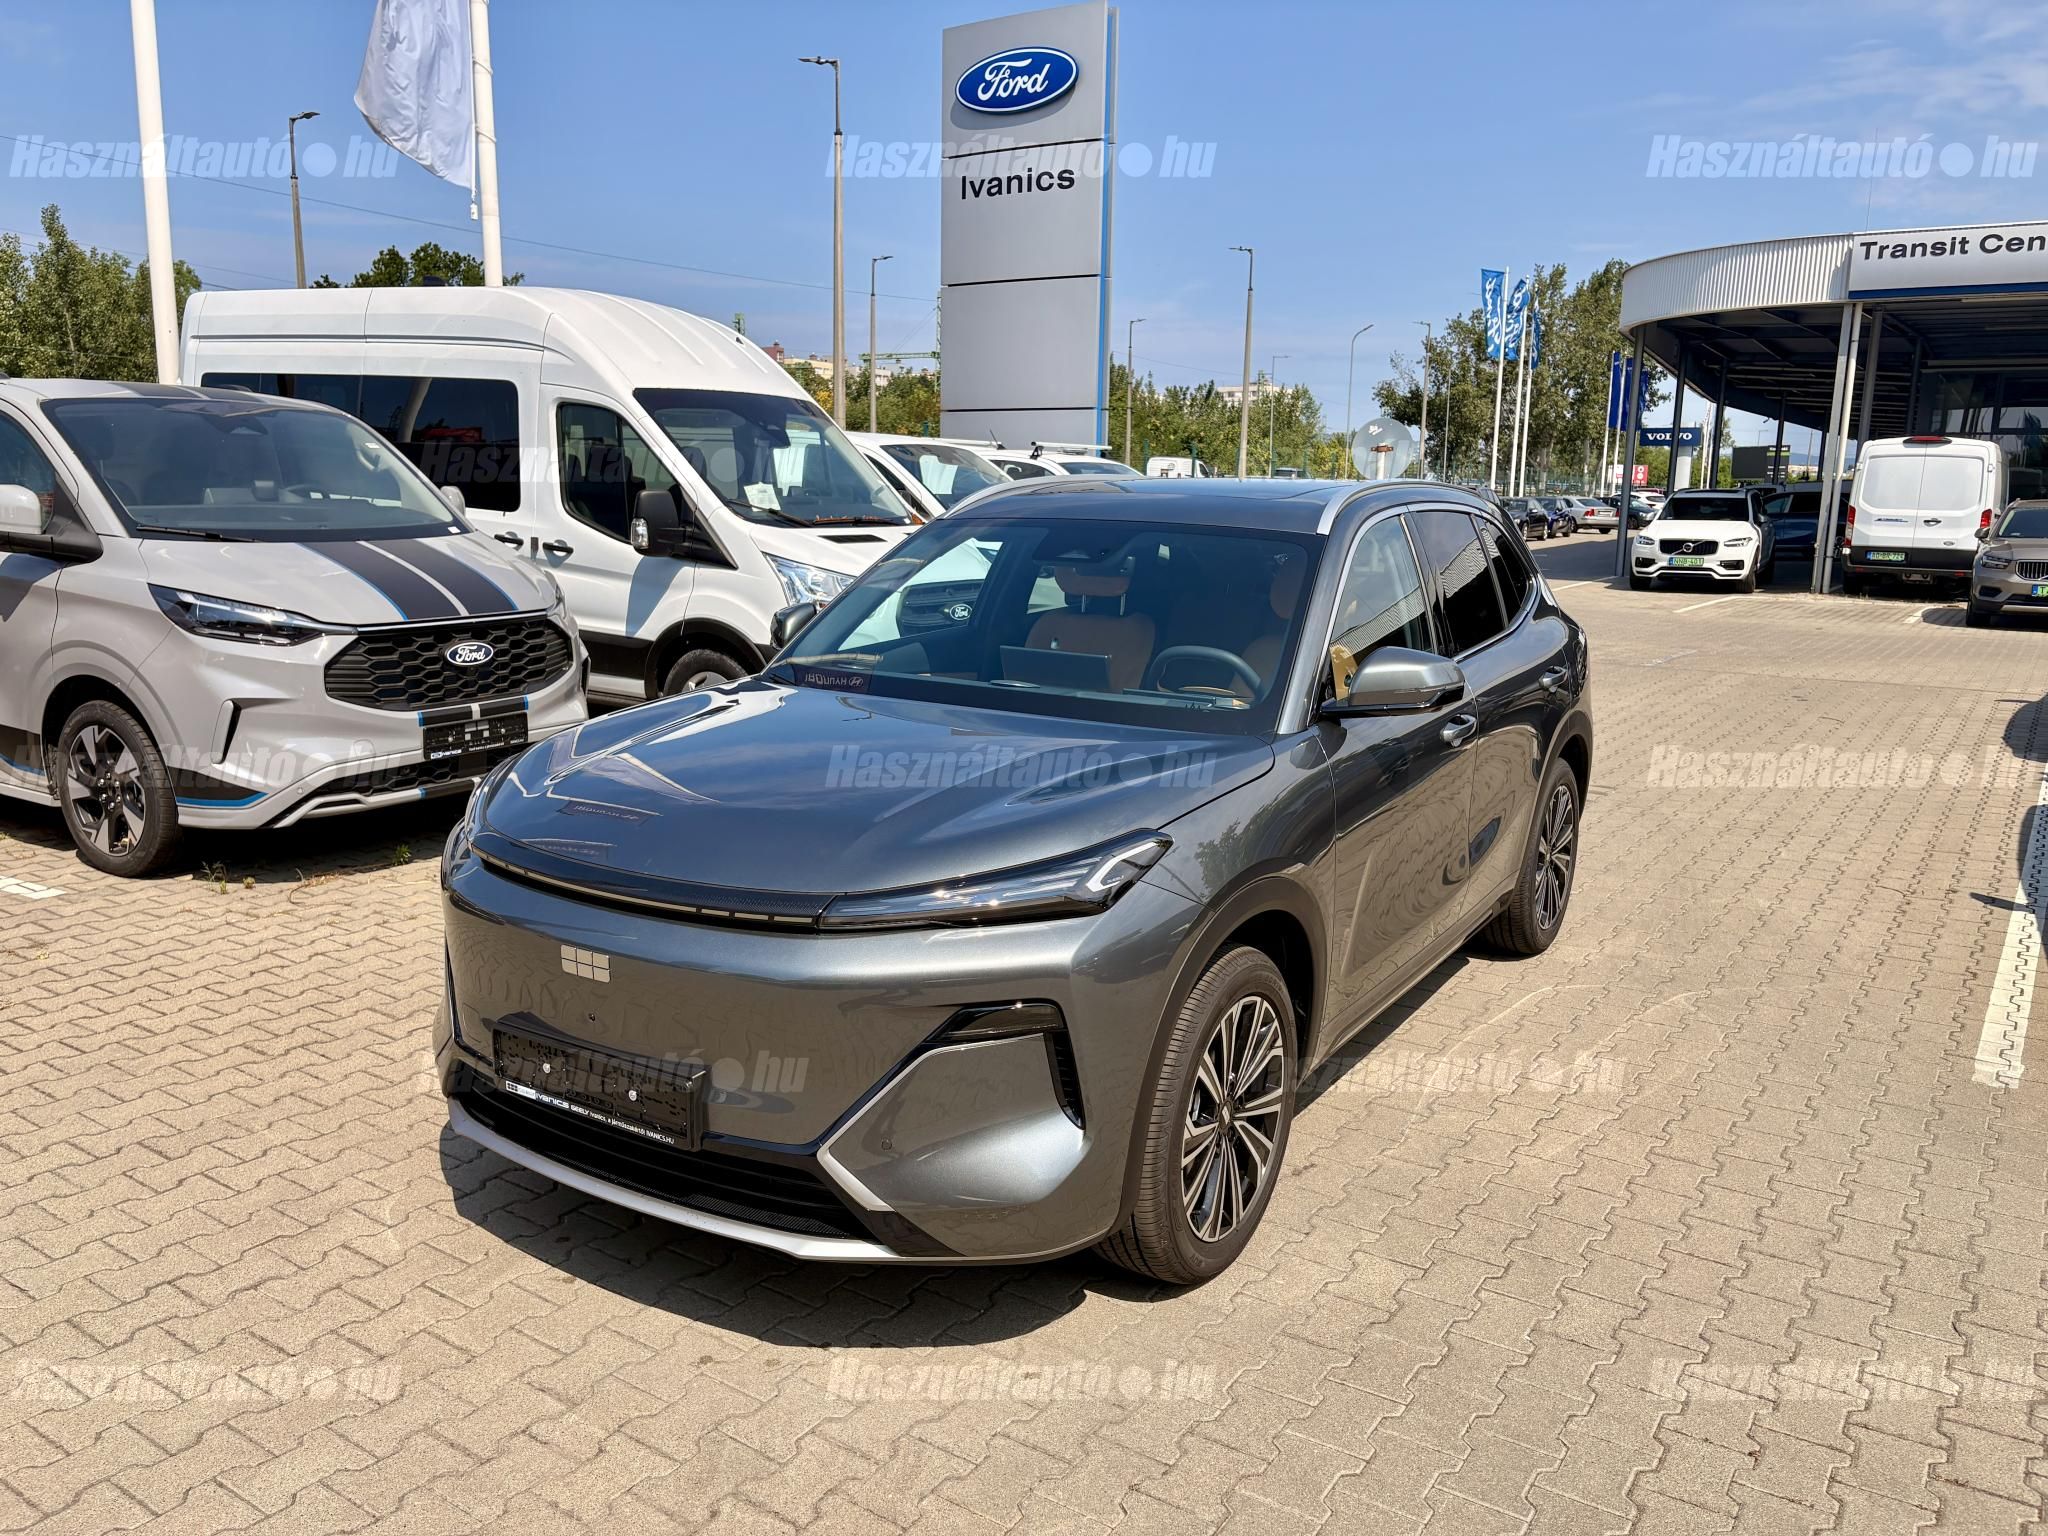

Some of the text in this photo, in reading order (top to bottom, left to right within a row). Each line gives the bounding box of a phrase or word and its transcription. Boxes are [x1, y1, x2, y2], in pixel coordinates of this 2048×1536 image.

[977, 58, 1051, 101] Ford
[961, 167, 1075, 200] Ivanics
[1860, 233, 2047, 260] Transit Cen
[456, 645, 486, 662] Ford
